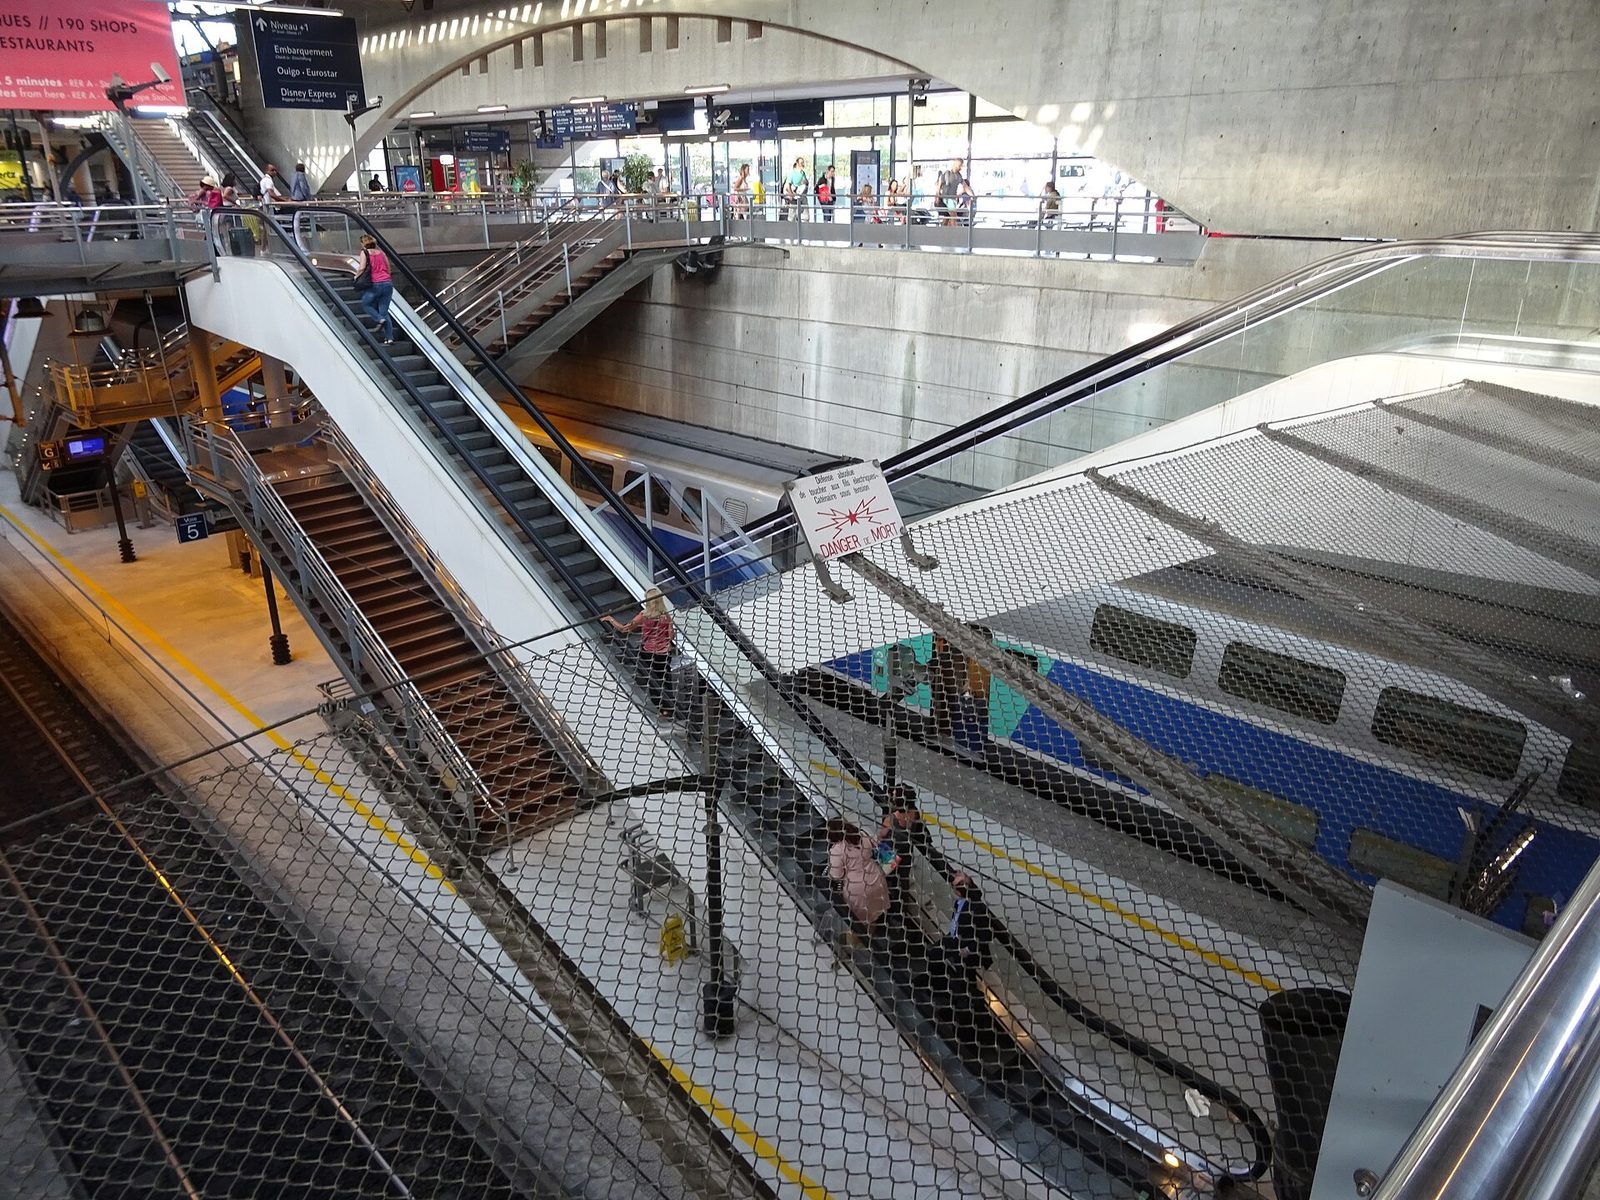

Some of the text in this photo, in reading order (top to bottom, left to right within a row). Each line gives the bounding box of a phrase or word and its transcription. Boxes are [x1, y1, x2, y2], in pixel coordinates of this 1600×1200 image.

[58, 17, 85, 31] 190
[91, 19, 138, 34] SHOPS
[270, 20, 298, 31] Niveau
[274, 44, 334, 57] Embarquement
[306, 68, 338, 78] Eurostar
[5, 76, 12, 85] 5
[16, 77, 62, 88] minutes
[19, 87, 41, 98] from
[44, 88, 65, 99] here
[280, 87, 306, 99] Disney
[308, 89, 337, 100] Express
[44, 448, 54, 458] G
[809, 486, 827, 496] toucher
[853, 485, 870, 494] tension
[187, 524, 199, 540] 5
[820, 534, 861, 558] DANGER
[871, 522, 899, 542] MORT
